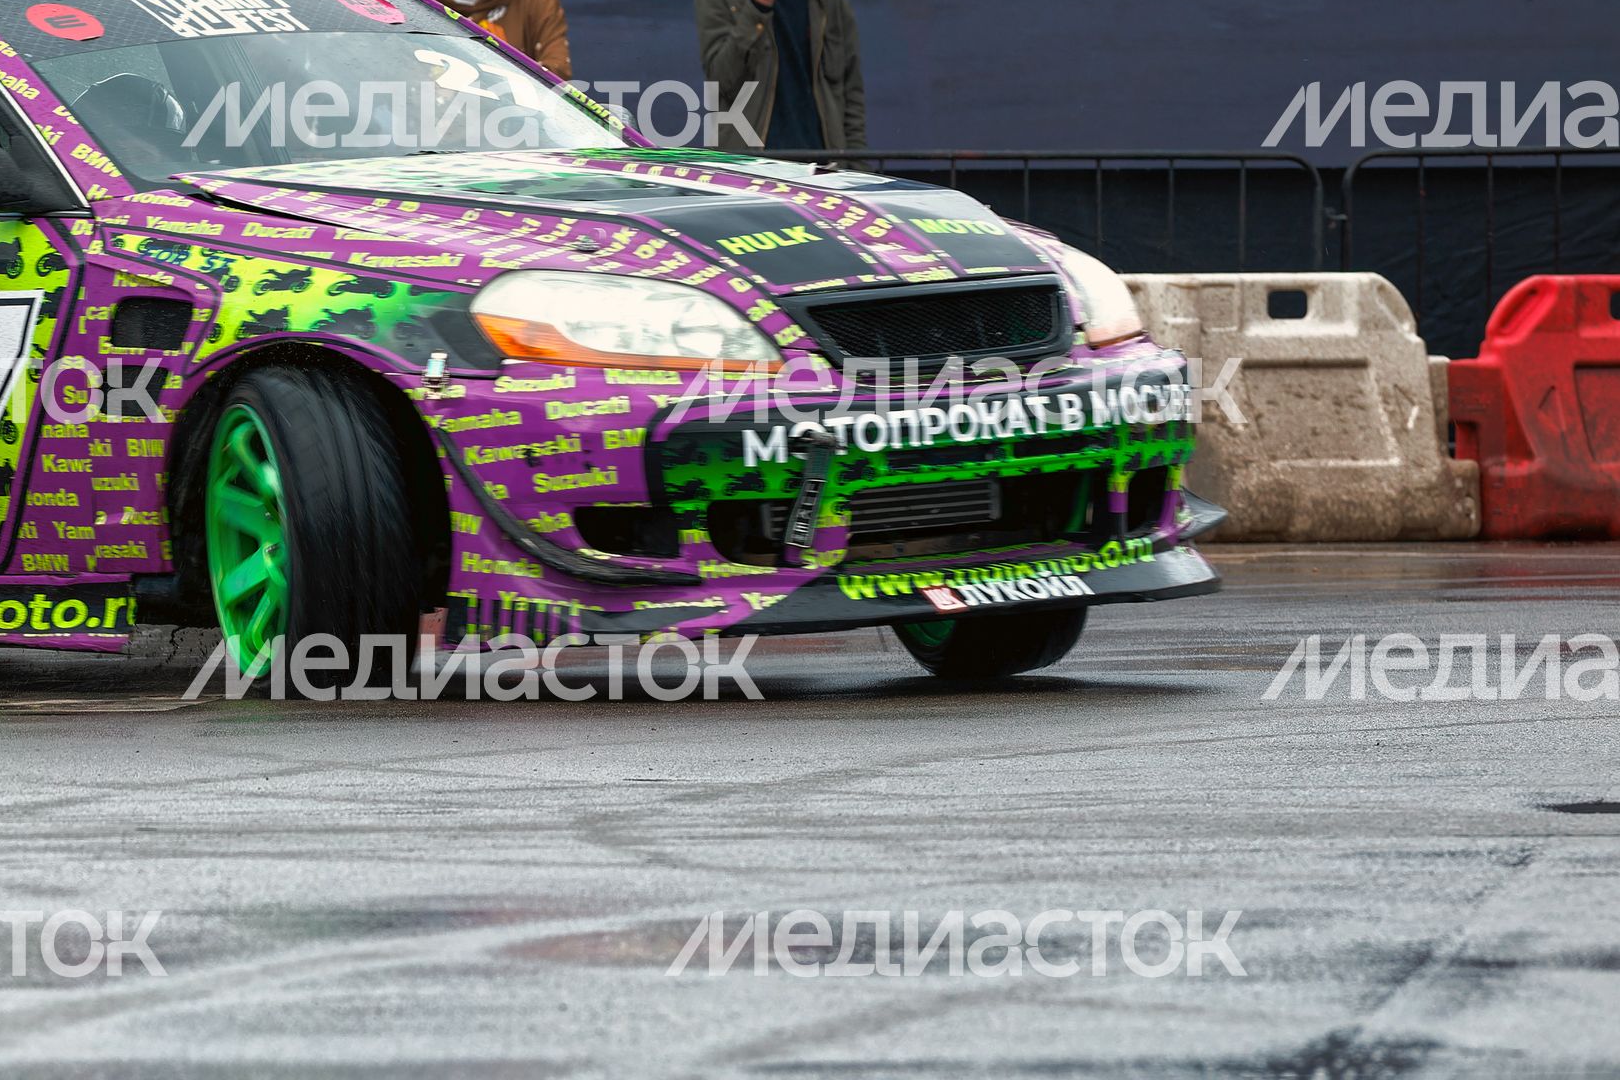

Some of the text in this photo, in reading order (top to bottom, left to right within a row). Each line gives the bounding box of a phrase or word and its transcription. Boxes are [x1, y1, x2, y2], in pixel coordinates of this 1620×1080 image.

[223, 8, 311, 33] FEST
[146, 216, 226, 236] Yamaha
[241, 222, 318, 240] Ducati
[909, 218, 1006, 236] MOTO
[716, 225, 823, 255] HULK
[347, 253, 466, 268] Kawasaki
[493, 368, 577, 393] Suzuki
[544, 396, 631, 420] Ducati
[1057, 393, 1086, 431] В
[533, 466, 619, 493] Suzuki
[956, 571, 1096, 606] ЛУКОЙЛ
